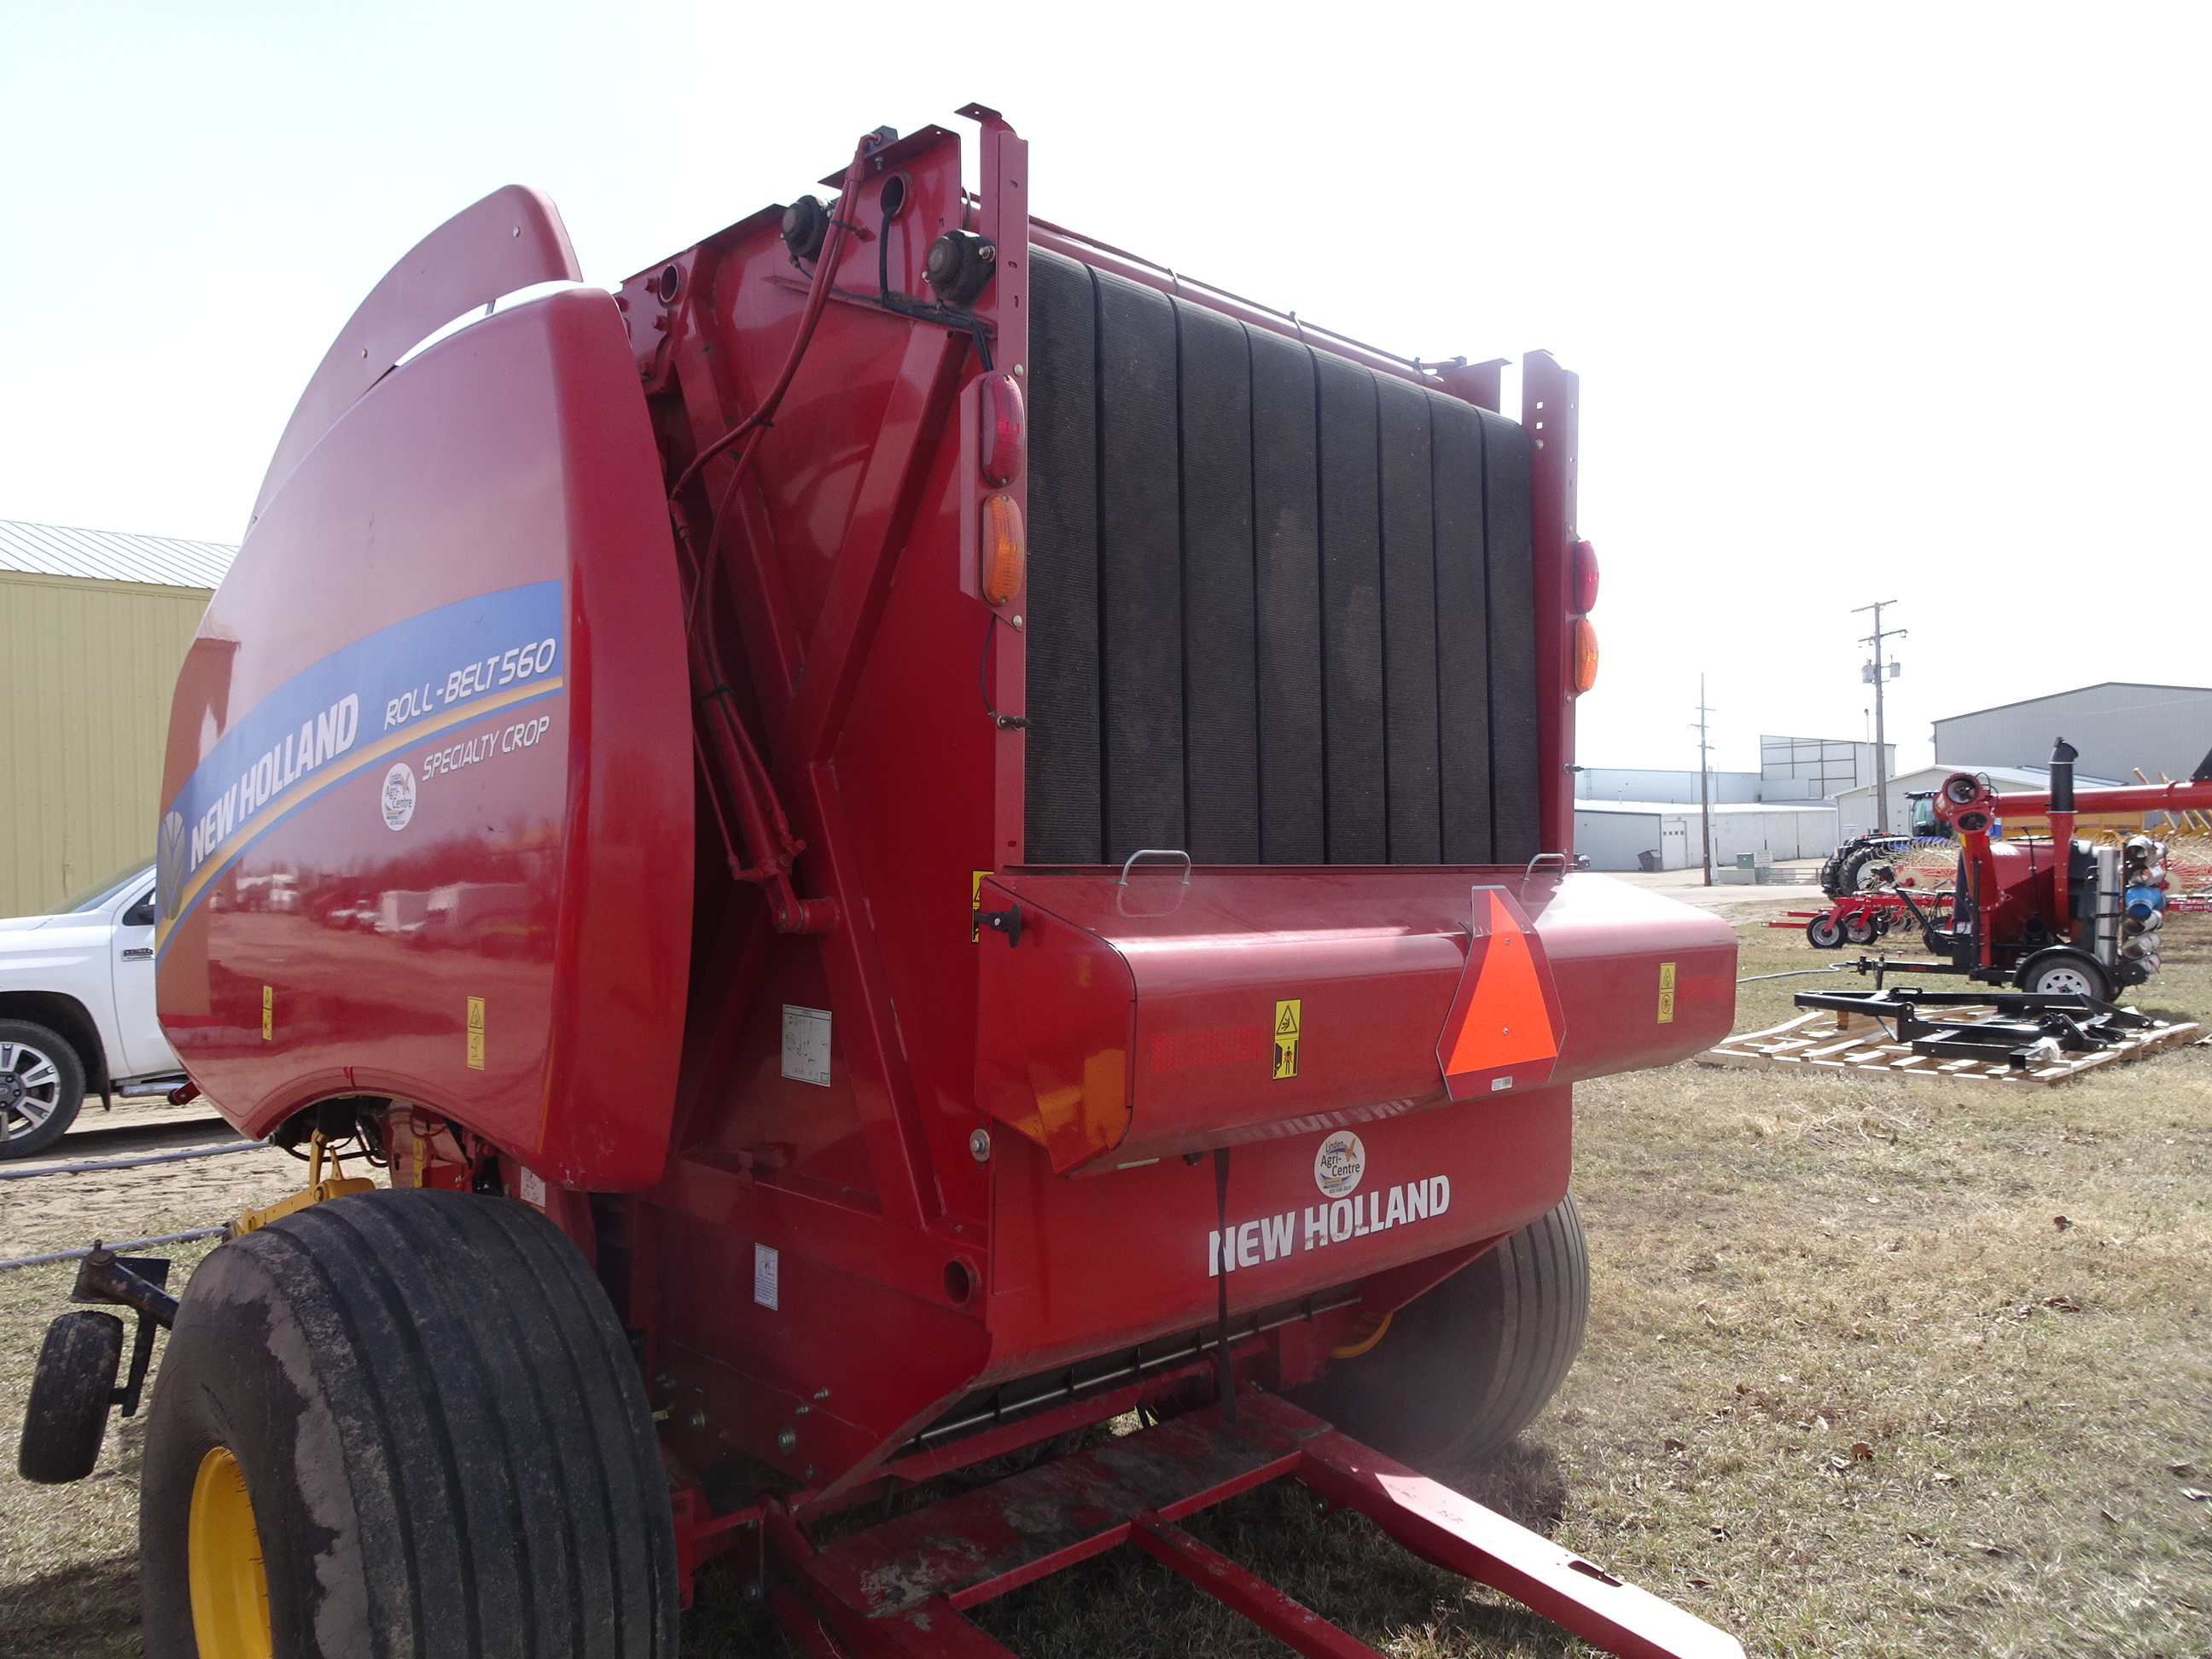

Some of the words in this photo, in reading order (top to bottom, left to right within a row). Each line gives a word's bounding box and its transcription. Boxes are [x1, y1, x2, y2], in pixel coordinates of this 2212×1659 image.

[499, 638, 556, 685] 560
[422, 731, 500, 782] SPECIALTY
[502, 716, 550, 753] CROP
[190, 783, 237, 872] NEW
[239, 693, 358, 822] HOLLAND
[393, 798, 412, 809] Centre
[1320, 1152, 1342, 1168] Agri-
[1325, 1140, 1344, 1152] Linden
[1332, 1163, 1360, 1177] Centre
[1208, 1211, 1295, 1278] NEW
[1304, 1175, 1450, 1250] HOLLAND
